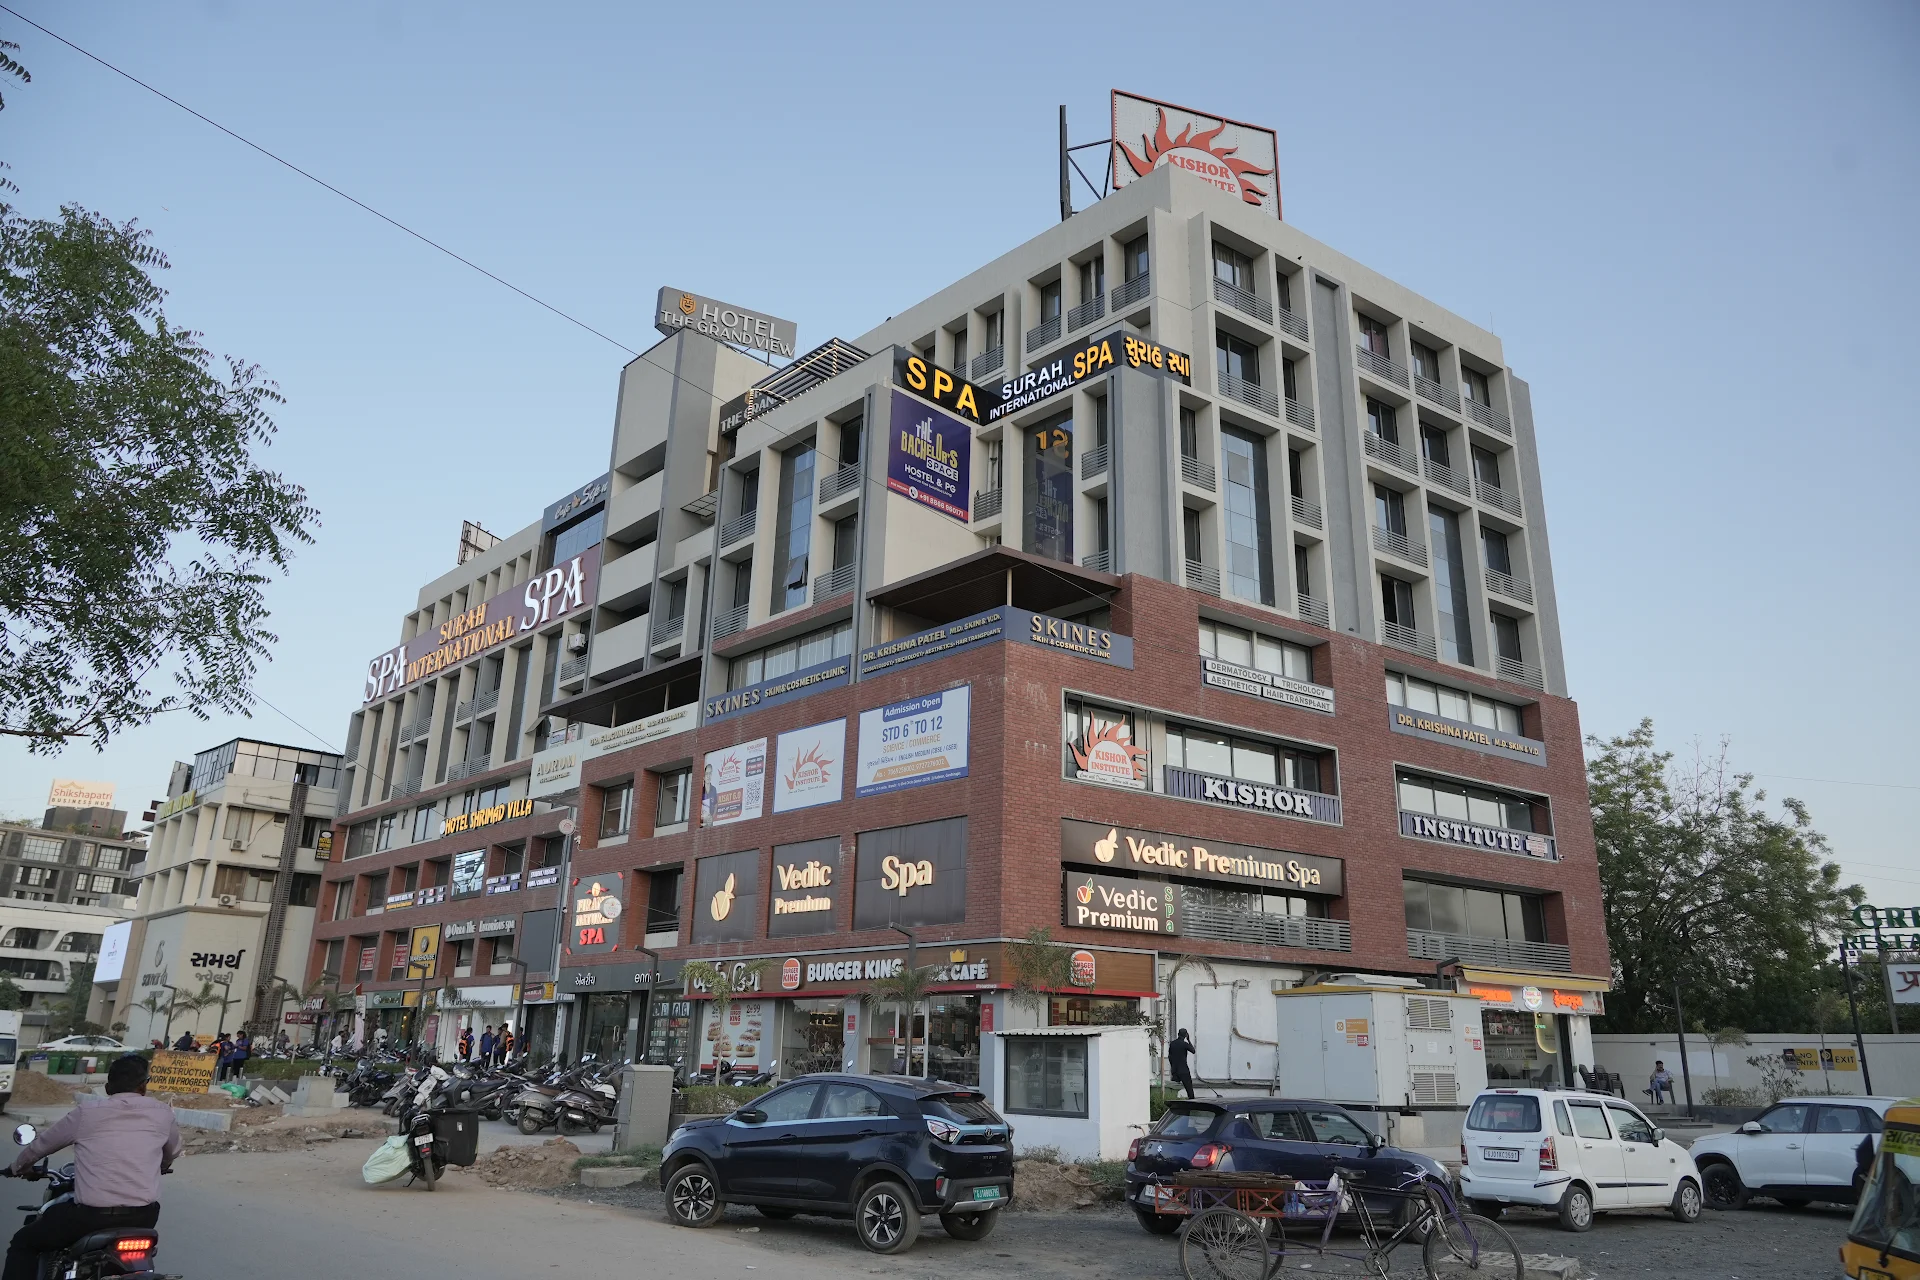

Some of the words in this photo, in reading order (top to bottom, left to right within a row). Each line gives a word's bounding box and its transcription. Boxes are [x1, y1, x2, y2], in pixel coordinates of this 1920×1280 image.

[1167, 154, 1231, 179] KISHOR
[661, 310, 693, 326] THE
[697, 322, 753, 345] GRAND
[754, 336, 796, 357] VIEW
[702, 303, 781, 341] HOTEL
[1002, 360, 1063, 400] SURAH
[1073, 340, 1115, 379] SPA
[906, 356, 979, 418] SPA
[989, 375, 1075, 420] INTERNATIONAL
[720, 411, 742, 432] THE
[916, 417, 932, 443] THE
[905, 464, 934, 484] HOSTEL
[937, 478, 943, 488] &
[945, 482, 956, 493] PG
[927, 457, 959, 482] SPACE
[519, 557, 585, 631] SPA
[438, 603, 488, 645] SURAH
[955, 638, 968, 647] HAIR
[968, 627, 1002, 642] TRANSPLANT
[1030, 615, 1111, 649] SKINES
[877, 639, 917, 657] KRISHNA
[964, 620, 981, 631] SKIN
[1032, 634, 1049, 644] SKIN
[1055, 640, 1089, 654] COSMETIC
[1089, 648, 1111, 658] CLINIC
[364, 646, 408, 702] SPA
[406, 616, 516, 684] INTERNATIONAL
[706, 689, 761, 717] SKINES
[764, 685, 782, 698] SKIN
[786, 672, 821, 691] COSMETIC
[821, 665, 847, 680] CLINIC
[1210, 662, 1267, 683] DERMATOLOGY
[1281, 679, 1325, 696] TRICHOLOGY
[1211, 675, 1258, 693] AESTHETICS
[1266, 688, 1284, 700] HAIR
[1285, 693, 1331, 711] TRANSPLANT
[884, 701, 920, 718] Admission
[921, 696, 941, 708] Open
[882, 725, 900, 742] STD
[914, 718, 927, 735] TO
[930, 715, 943, 731] 12
[1397, 713, 1415, 727] DR.
[1417, 718, 1461, 739] KRISHNA
[1463, 729, 1490, 745] PATEL
[1508, 741, 1524, 752] SKIN
[883, 741, 905, 754] SCIENCE
[908, 734, 941, 748] COMMERCE
[1095, 750, 1127, 765] KISHOR
[1091, 761, 1130, 776] INSTITUTE
[51, 797, 92, 805] BUSINESS
[53, 788, 113, 800] Shikshapatri
[1203, 777, 1313, 816] KISHOR
[445, 814, 469, 836] HOTEL
[470, 805, 505, 830] SHRIMAD
[507, 799, 533, 820] VILLA
[1413, 816, 1522, 851] INSTITUTE
[776, 860, 832, 891] Vedic
[1125, 836, 1188, 869] Vedic
[1192, 846, 1285, 882] Premium
[1286, 860, 1321, 888] Spa
[881, 855, 934, 897] Spa
[774, 894, 831, 915] Premium
[1097, 885, 1158, 912] Vedic
[1076, 905, 1159, 932] Premium
[579, 927, 605, 945] SPA
[190, 949, 246, 970] સમર્થ
[807, 960, 862, 982] BURGER
[864, 958, 903, 980] KING
[950, 958, 988, 981] CAFÉ
[783, 974, 798, 983] KING
[165, 1052, 206, 1061] RESTRICTED
[1835, 1056, 1855, 1064] EXIT
[150, 1066, 213, 1078] CONSTRUCTION
[167, 1076, 176, 1084] IN
[176, 1077, 211, 1088] PROGRESS
